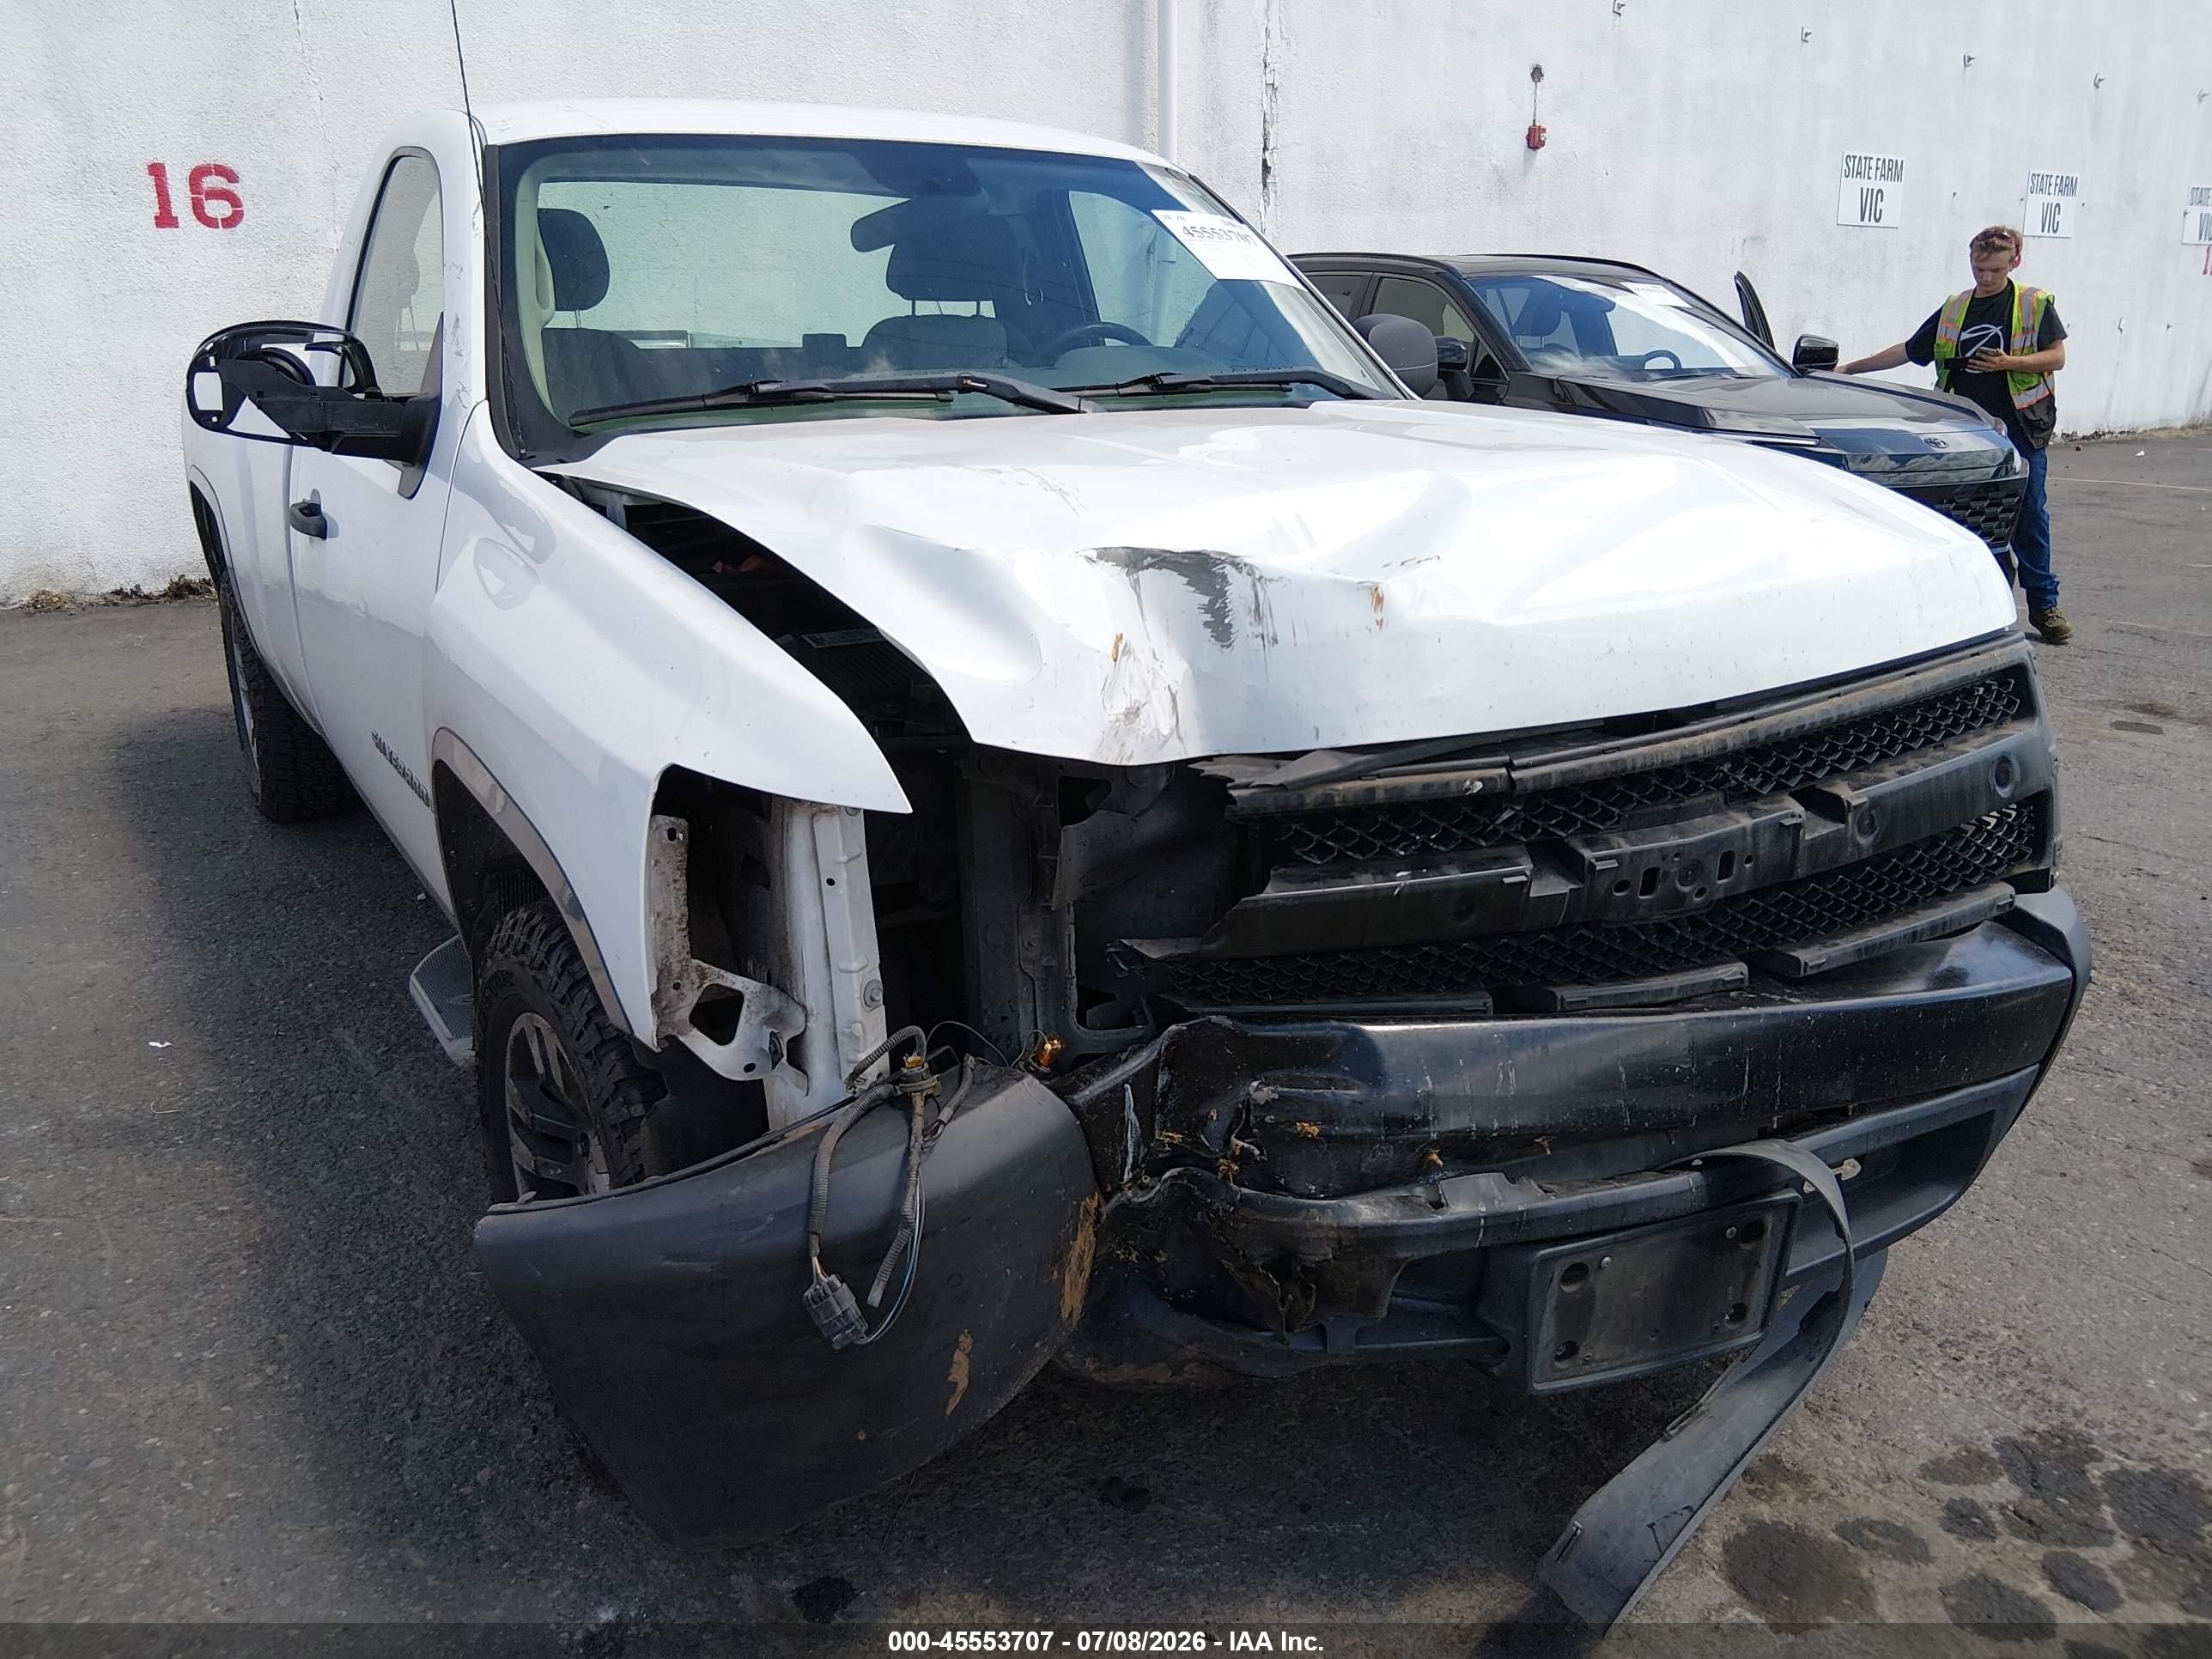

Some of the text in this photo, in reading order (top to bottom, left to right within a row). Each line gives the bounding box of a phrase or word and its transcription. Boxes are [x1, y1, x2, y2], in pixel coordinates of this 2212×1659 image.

[1844, 155, 1904, 183] STATE FARM
[147, 162, 244, 229] 16
[2029, 173, 2078, 198] STATE FARM
[1859, 186, 1884, 223] VIC
[2040, 202, 2061, 234] VIC
